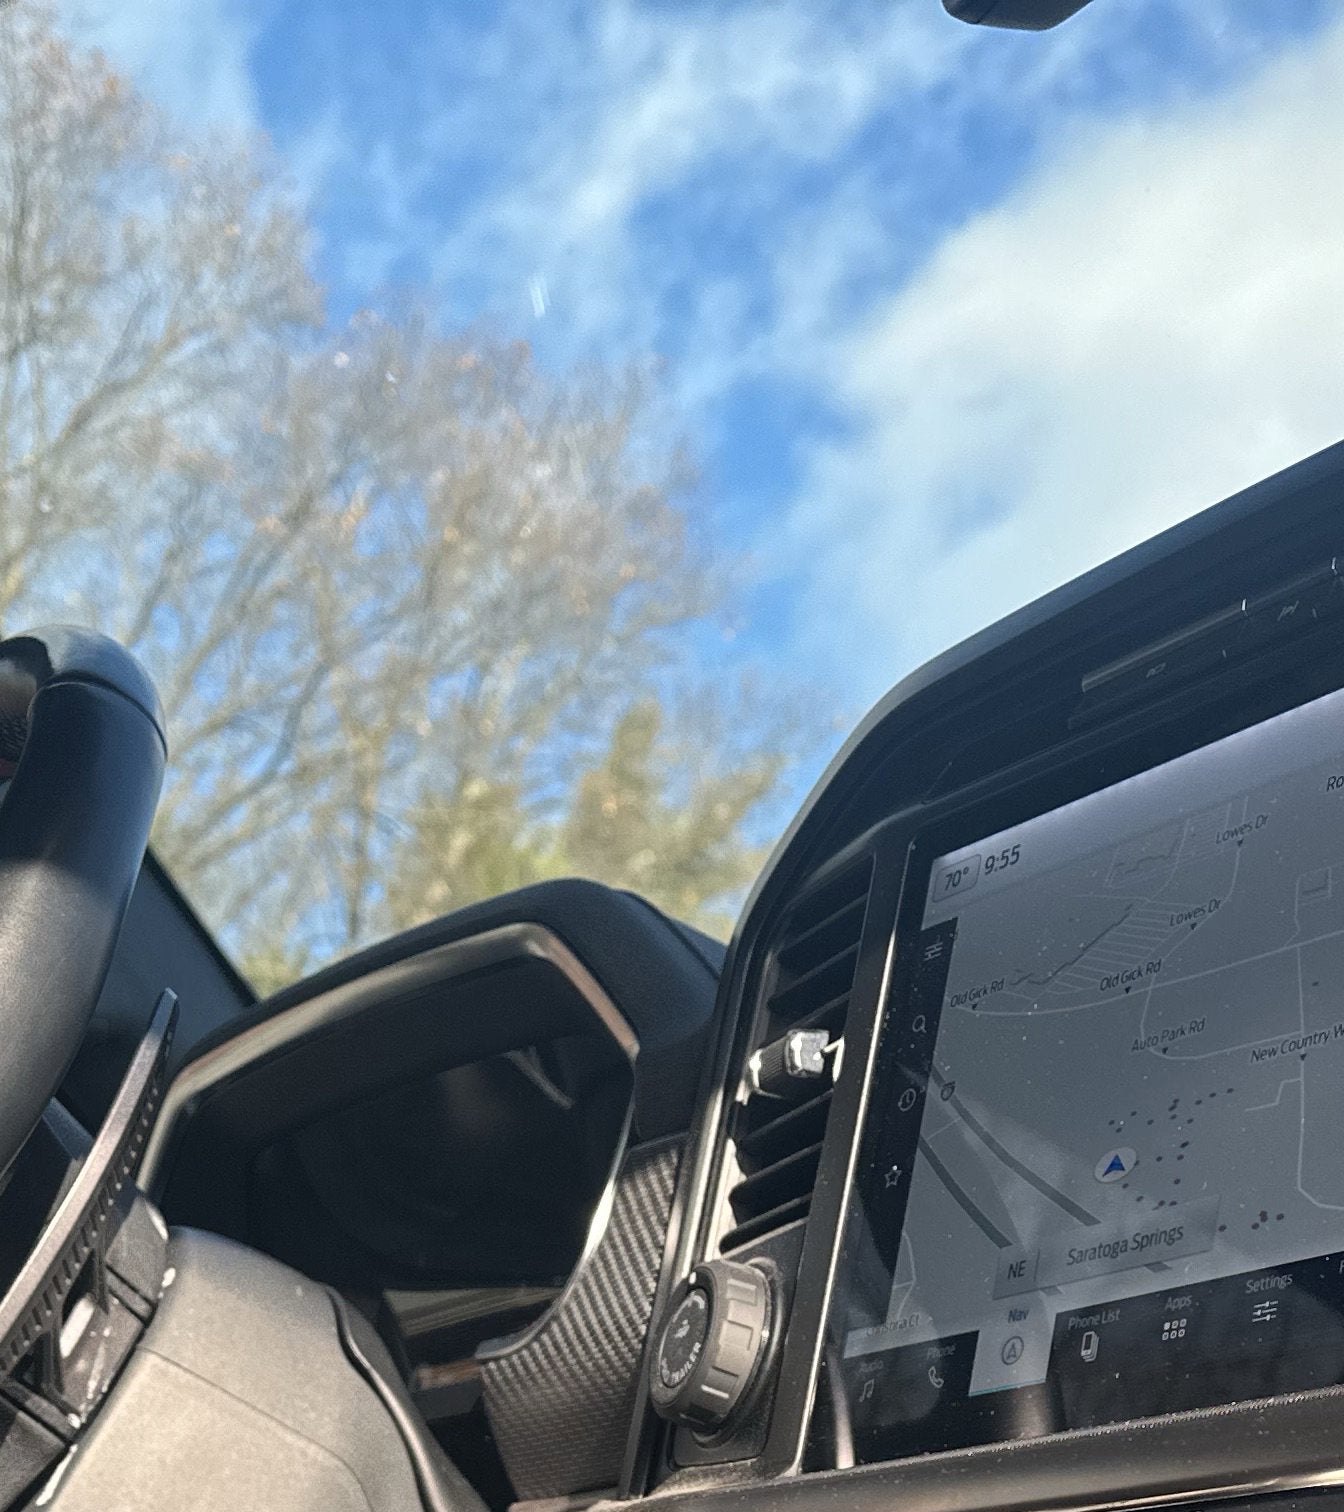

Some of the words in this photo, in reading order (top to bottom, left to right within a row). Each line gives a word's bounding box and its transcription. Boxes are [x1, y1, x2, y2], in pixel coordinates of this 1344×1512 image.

[1215, 821, 1254, 845] Lowes
[1255, 814, 1269, 830] Dr
[984, 844, 1021, 876] 9:55
[1169, 904, 1207, 927] Lowes
[1208, 898, 1222, 913] Dr
[1100, 972, 1119, 991] Old
[1146, 958, 1162, 975] Rd
[950, 990, 968, 1007] Old
[990, 977, 1005, 993] Rd
[1131, 1035, 1159, 1052] Auto
[1161, 1025, 1186, 1043] Park
[1189, 1017, 1206, 1034] Rd
[1250, 1045, 1278, 1064] New
[1280, 1031, 1330, 1055] Country
[1066, 1238, 1129, 1267] Saratoga
[1130, 1224, 1185, 1252] Springs
[1007, 1259, 1027, 1280] NE
[1245, 1271, 1294, 1294] Settings
[1007, 1308, 1031, 1324] Nav
[1165, 1295, 1193, 1312] Apps
[1068, 1314, 1100, 1331] Phone
[1101, 1309, 1121, 1325] List
